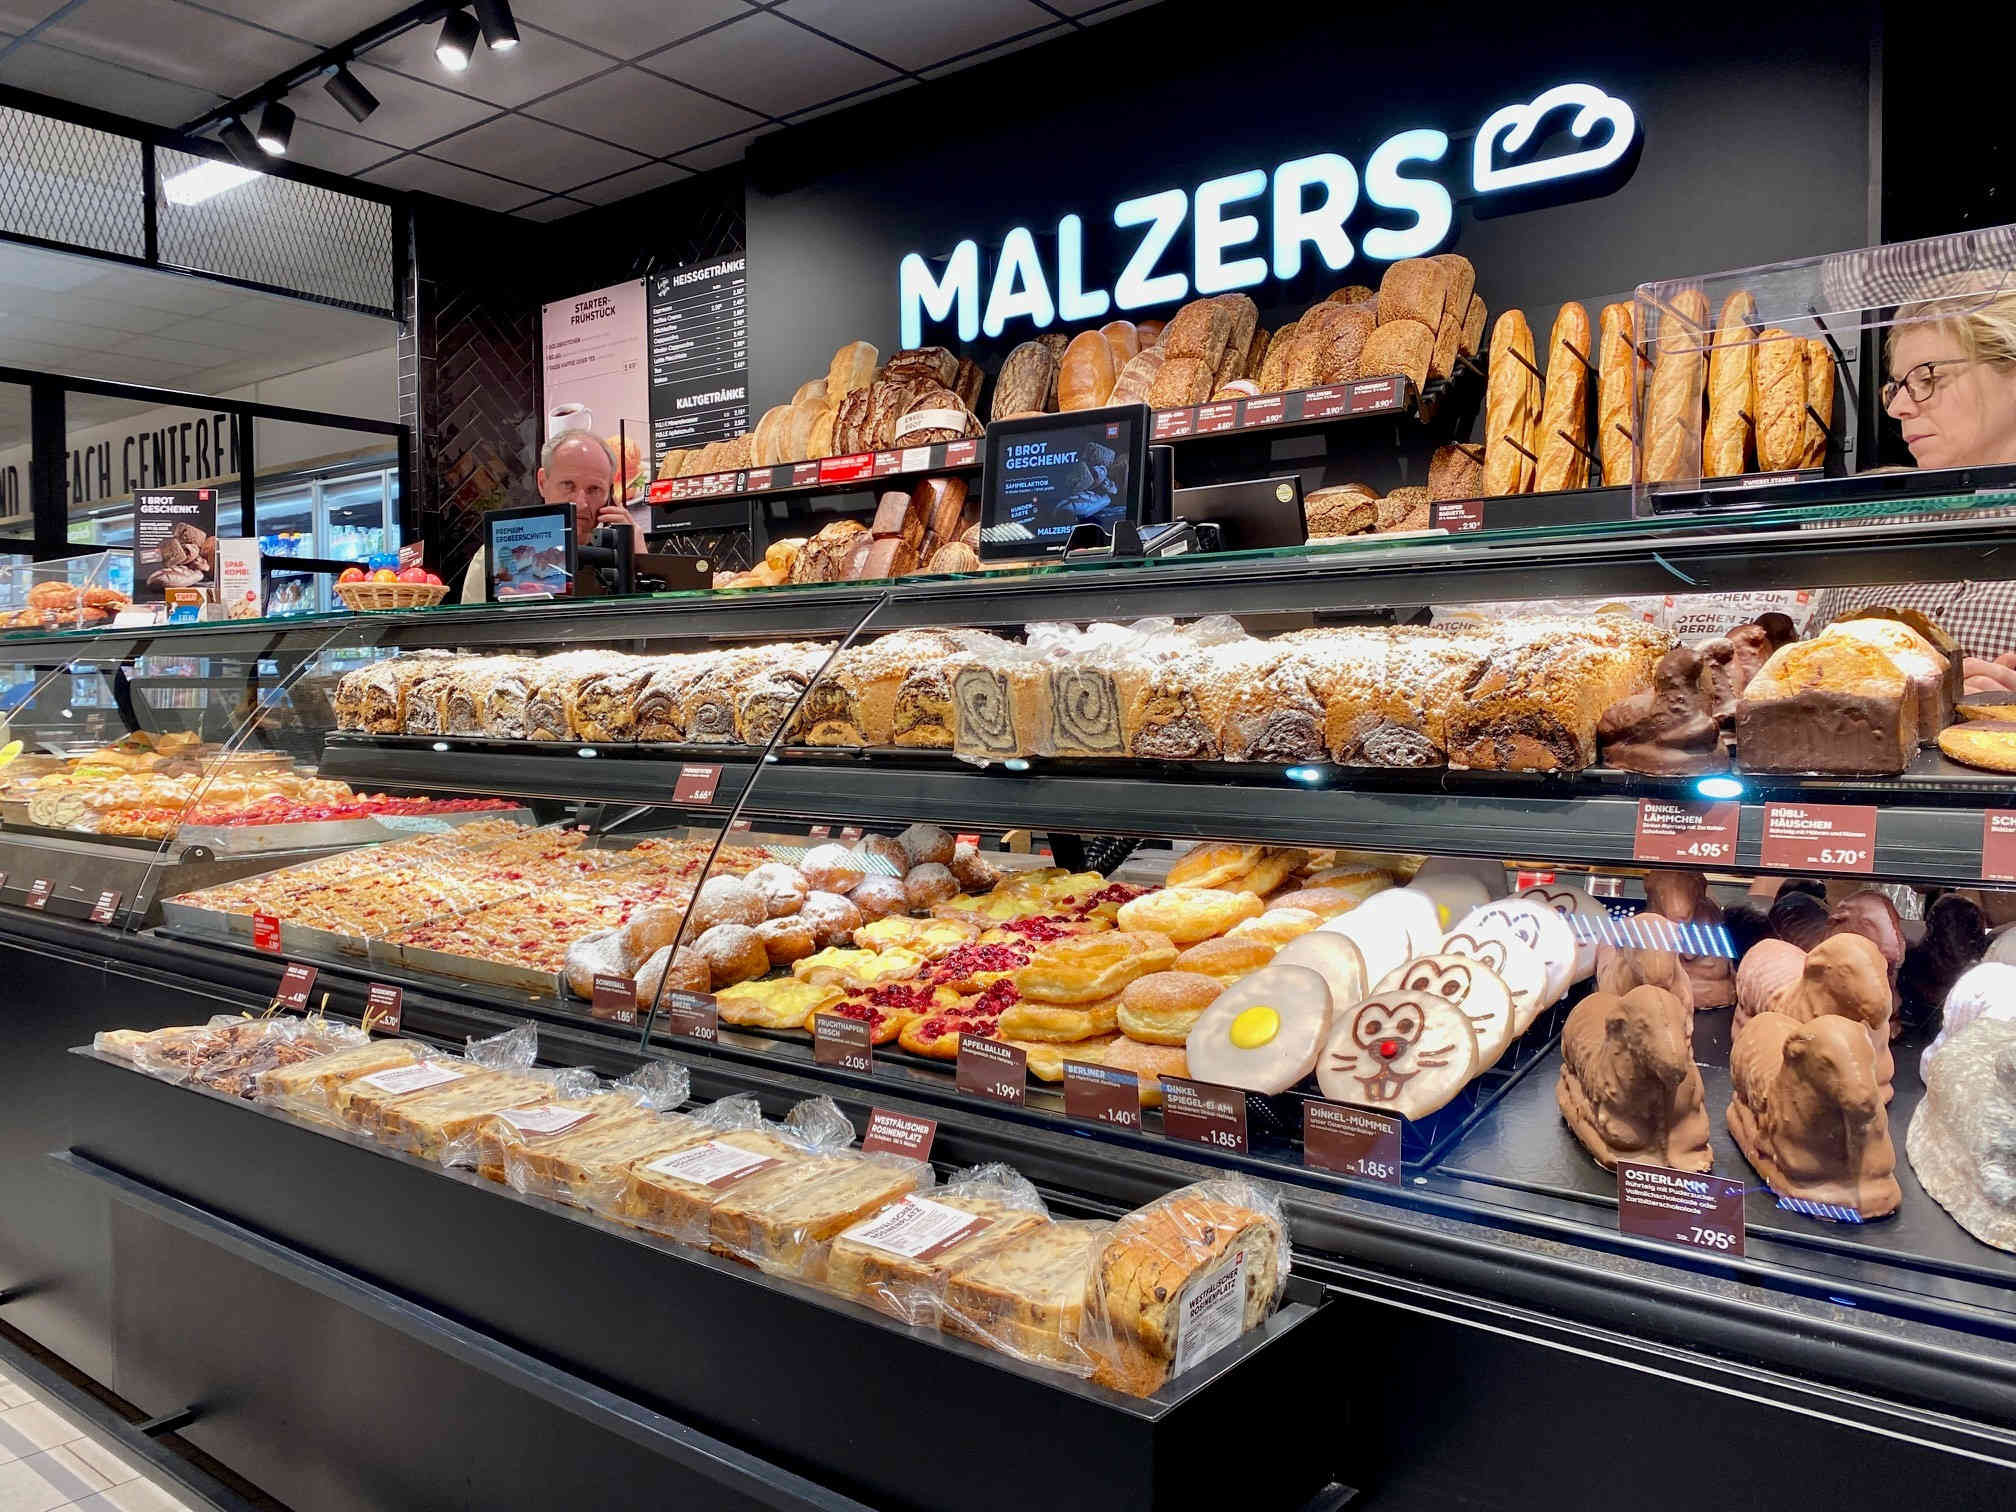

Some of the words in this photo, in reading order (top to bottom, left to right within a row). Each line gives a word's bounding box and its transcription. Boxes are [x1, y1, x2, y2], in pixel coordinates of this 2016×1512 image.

[900, 128, 1453, 350] MALZERS
[673, 259, 745, 287] HEISSGETRÄNKE
[676, 387, 745, 410] KALTGETRÄNKE
[1014, 442, 1048, 456] BROT
[1006, 451, 1080, 470] GESCHENKT.
[147, 497, 174, 505] BROT
[140, 504, 200, 514] GESCHENKT.
[1644, 804, 1686, 814] DINKEL-
[1769, 807, 1809, 819] RÜBLI-
[1643, 813, 1703, 825] LÄMMCHEN
[1769, 817, 1833, 830] HÄUSCHEN
[1068, 1064, 1105, 1078] BERLINER
[1167, 1084, 1198, 1097] DINKEL
[874, 1114, 930, 1135] WESTFÄLISCHER
[1310, 1107, 1394, 1135] DINKEL-MÜMMEL
[871, 1124, 923, 1144] ROSINENPLATZ
[1625, 1169, 1710, 1194] OSTERLAMM
